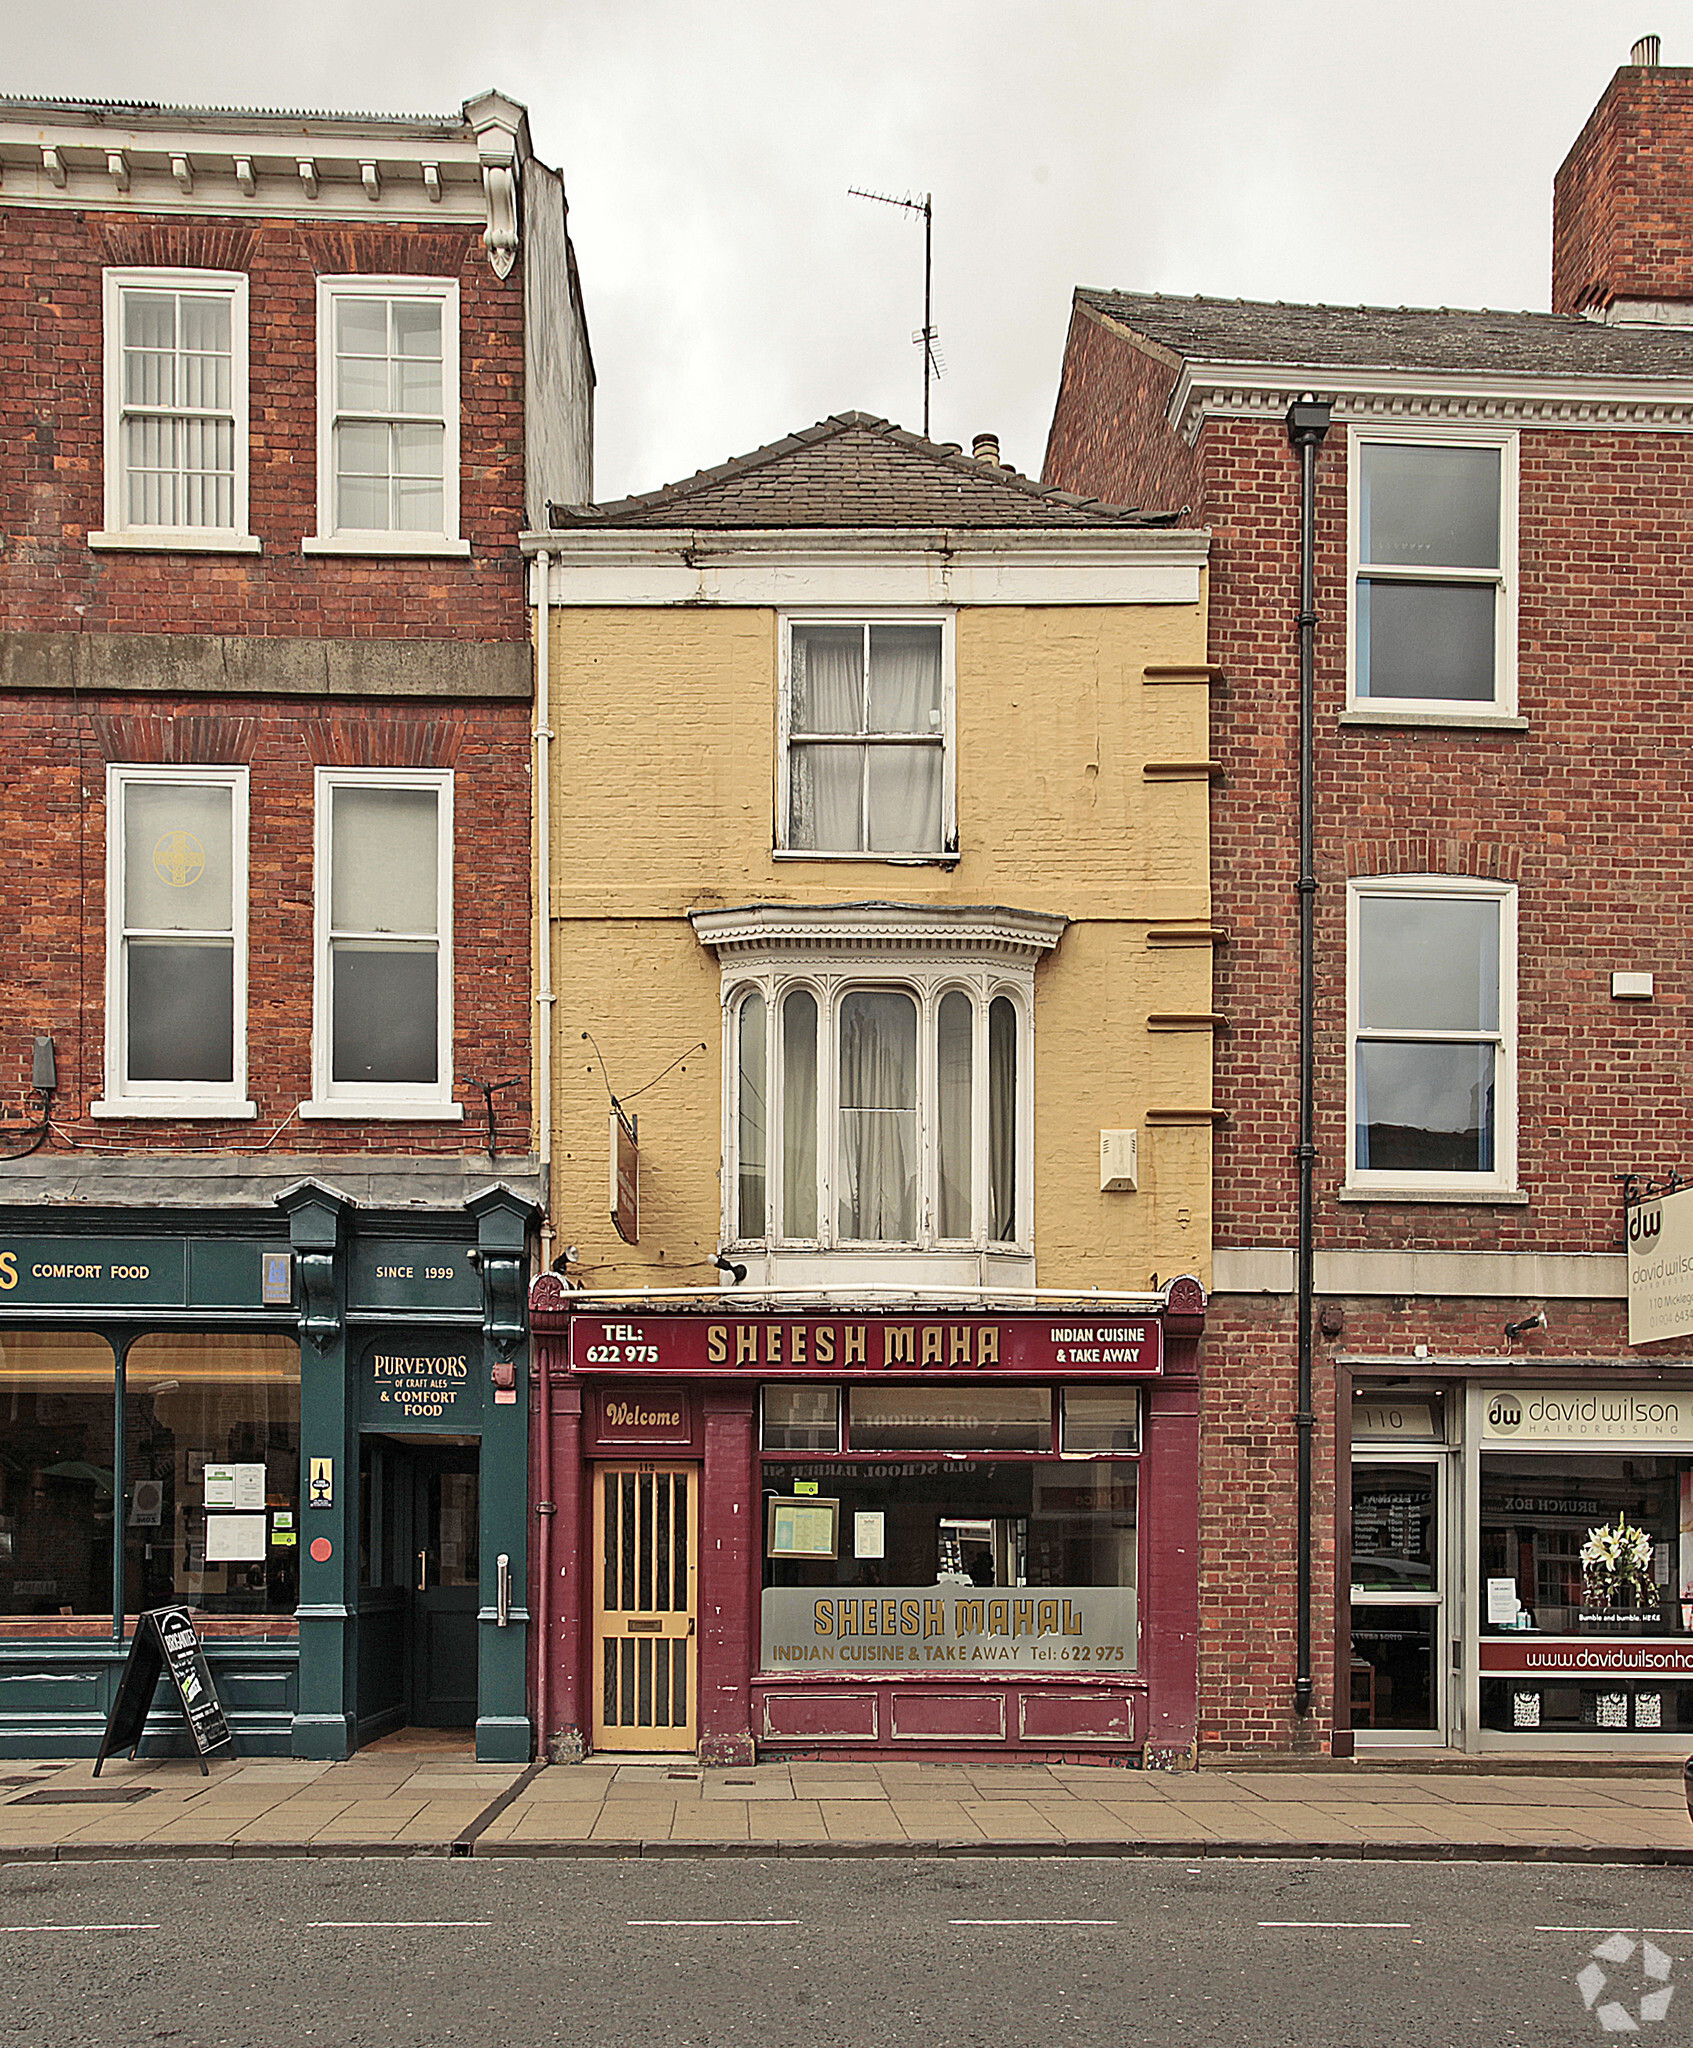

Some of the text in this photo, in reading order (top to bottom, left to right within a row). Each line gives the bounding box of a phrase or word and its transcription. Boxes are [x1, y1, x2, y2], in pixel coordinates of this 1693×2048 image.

[1629, 1206, 1661, 1241] dw
[31, 1263, 150, 1279] COMFORT FOOD
[375, 1266, 454, 1279] SINCE 1999
[601, 1324, 644, 1341] TEL:
[1050, 1328, 1146, 1343] INDIAN CUISINE
[586, 1346, 659, 1363] 622 975
[707, 1325, 999, 1368] SHEESH MAHA
[1056, 1349, 1140, 1363] & TAKE AWAY
[373, 1354, 468, 1378] PURVEYORS
[405, 1378, 428, 1389] CRAFT
[429, 1379, 448, 1389] ALES
[380, 1390, 458, 1404] & COMFORT
[403, 1403, 443, 1417] FOOD
[606, 1402, 680, 1427] Welcome
[1488, 1403, 1521, 1426] dw
[1365, 1410, 1404, 1429] 110
[1528, 1424, 1679, 1435] HAIRDRESSING
[638, 1462, 656, 1472] 112
[813, 1598, 1083, 1640] SHEESH MAHAL
[1578, 1613, 1603, 1622] Bumble
[1603, 1613, 1616, 1622] and
[164, 1628, 197, 1653] BRIGANTES
[773, 1645, 1125, 1662] INDIAN CUISINE & TAKE AWAY Tel: 622 975
